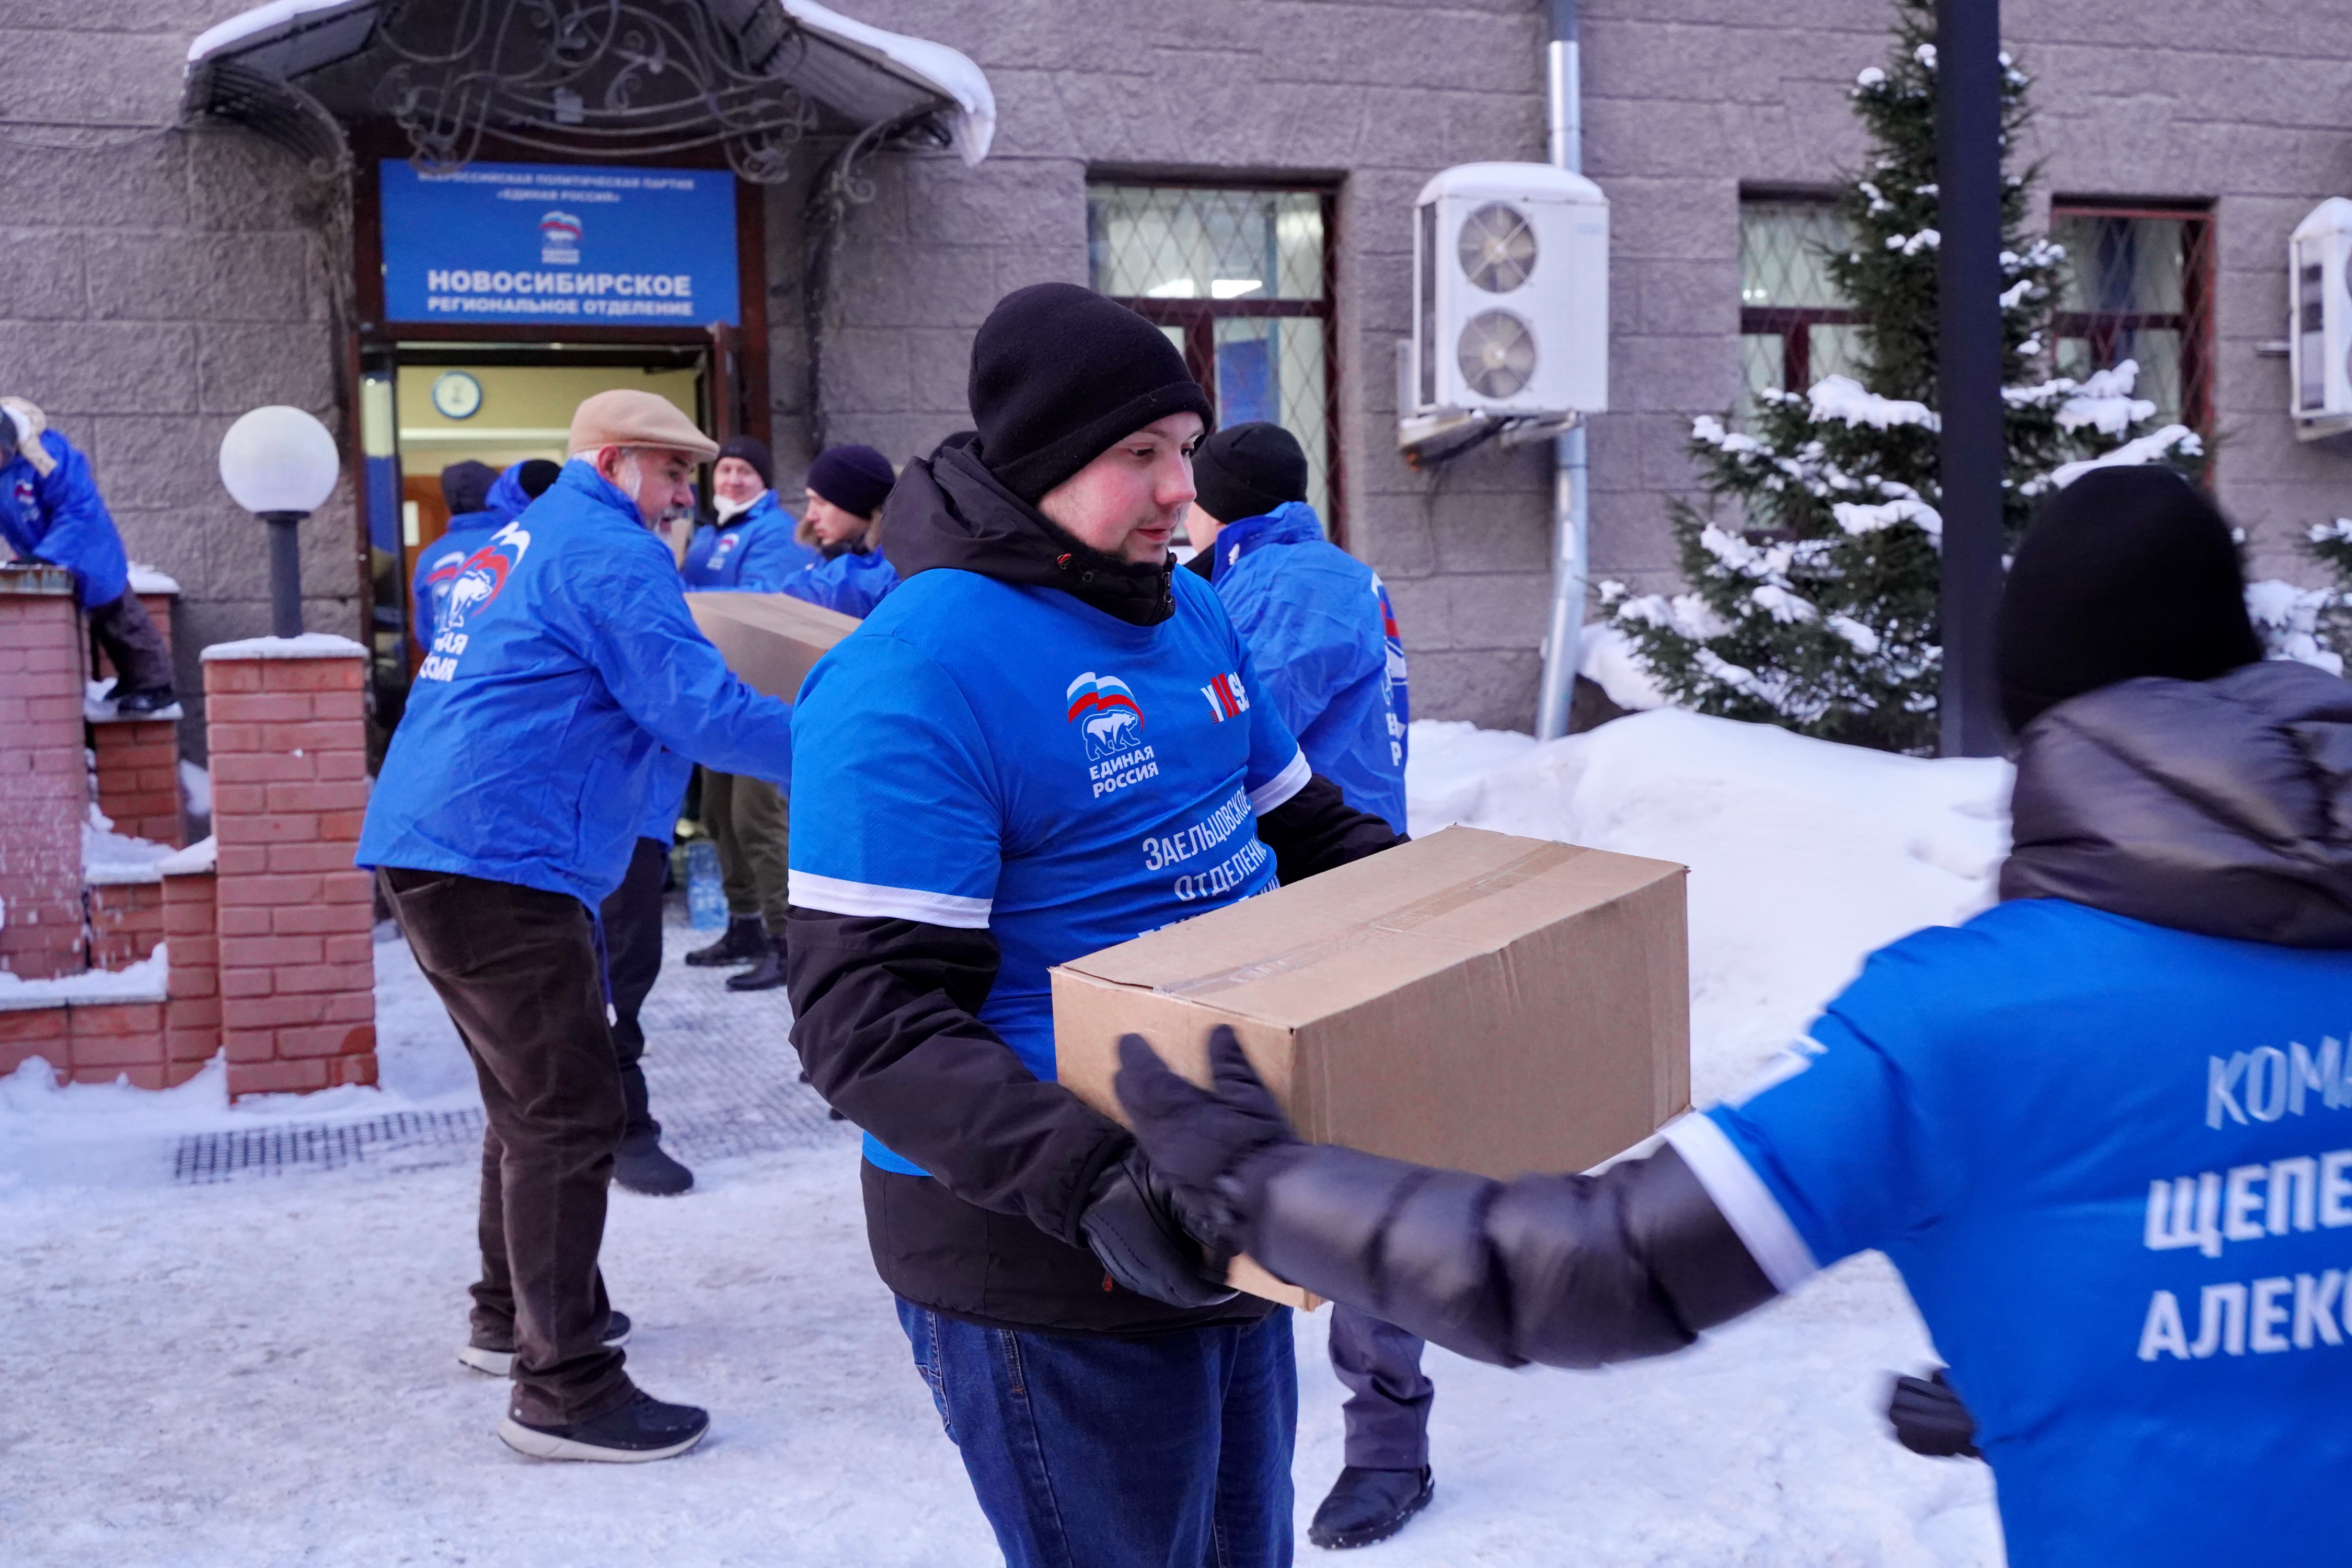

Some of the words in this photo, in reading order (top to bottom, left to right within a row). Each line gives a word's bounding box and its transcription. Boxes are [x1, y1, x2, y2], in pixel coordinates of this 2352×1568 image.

[427, 269, 692, 297] НОВОСИБИРСКОЕ
[427, 295, 578, 314] РЕГИОНАЛЬНОЕ
[582, 299, 694, 316] ОТДЕЛЕНИЕ
[1089, 745, 1155, 781] ЕДИНАЯ
[1092, 761, 1159, 799] РОССИЯ
[1142, 785, 1252, 871] ЗАЕЛЬЦОВСКОЕ
[2206, 1031, 2352, 1131] КОМ
[2143, 1148, 2352, 1258] ЩЕПЕ
[2136, 1267, 2352, 1362] АЛЕК
